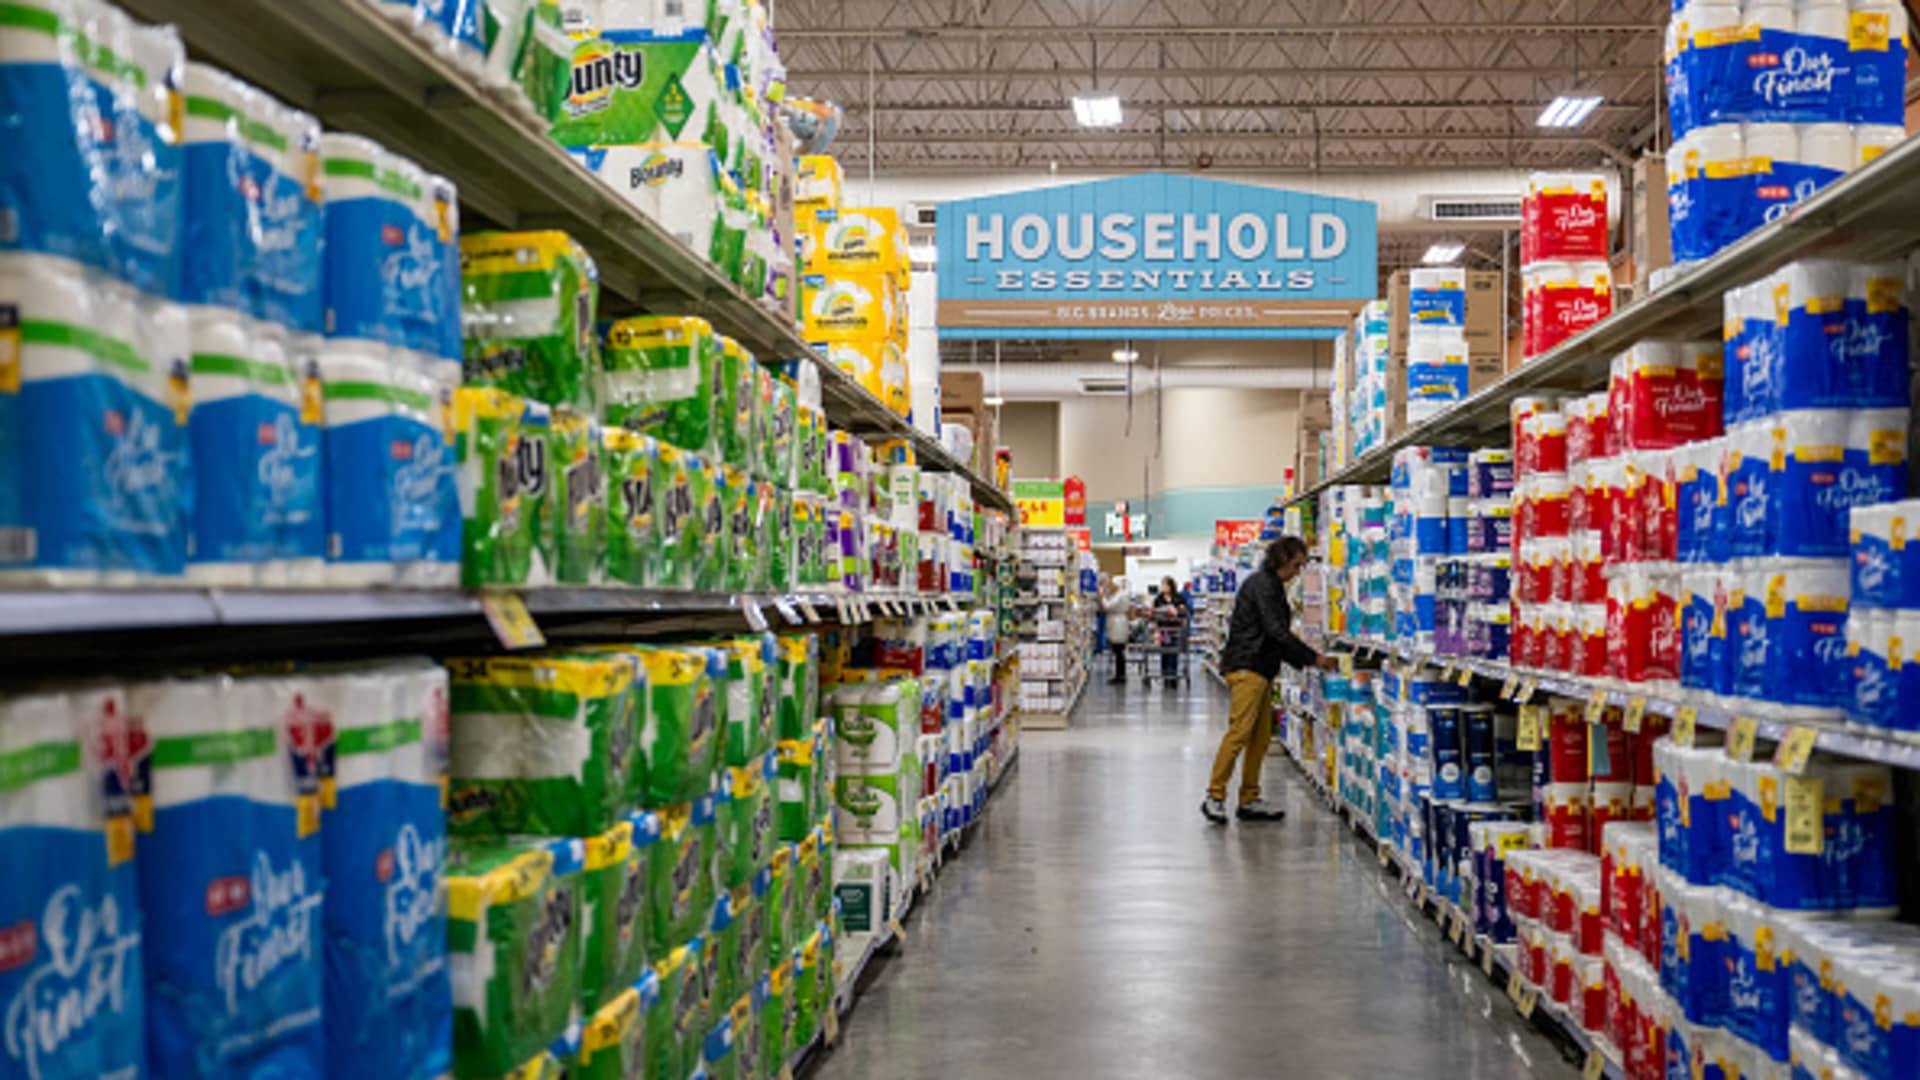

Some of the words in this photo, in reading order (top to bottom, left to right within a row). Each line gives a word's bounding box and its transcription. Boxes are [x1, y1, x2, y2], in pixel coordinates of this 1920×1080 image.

[566, 51, 642, 98] unty
[1783, 47, 1833, 75] Our
[1753, 67, 1850, 104] Finest
[630, 159, 683, 189] Bounty
[965, 213, 1348, 260] HOUSEHOLD
[996, 270, 1315, 290] ESSENTIALS
[1839, 468, 1878, 492] Our
